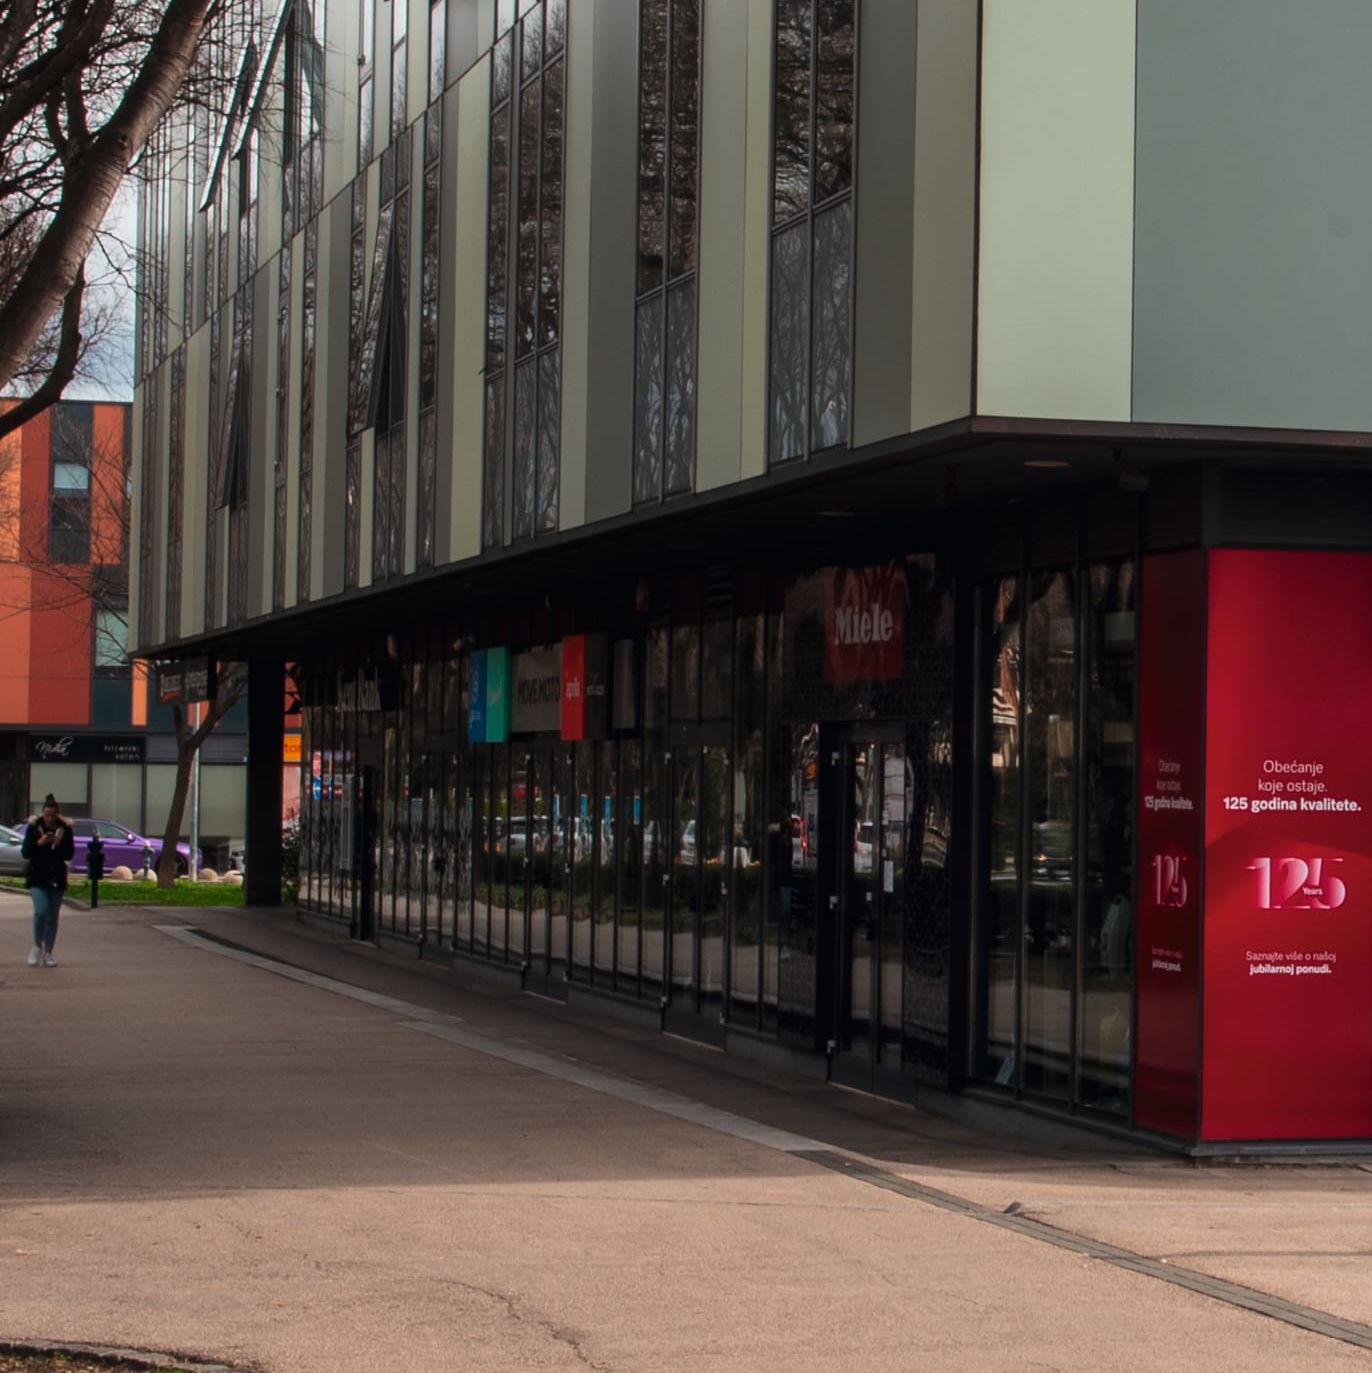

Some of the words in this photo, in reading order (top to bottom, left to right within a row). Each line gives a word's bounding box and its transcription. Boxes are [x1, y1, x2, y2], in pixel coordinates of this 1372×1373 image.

[834, 602, 894, 646] Miele
[1263, 759, 1324, 777] Obećanje
[1258, 778, 1284, 795] koje
[1286, 779, 1328, 796] ostaje.
[1223, 796, 1249, 810] 125
[1251, 797, 1297, 813] godina
[1300, 797, 1362, 812] kvalitete.
[1243, 857, 1346, 909] 125
[1245, 951, 1284, 963] Saznajte
[1285, 951, 1303, 961] više
